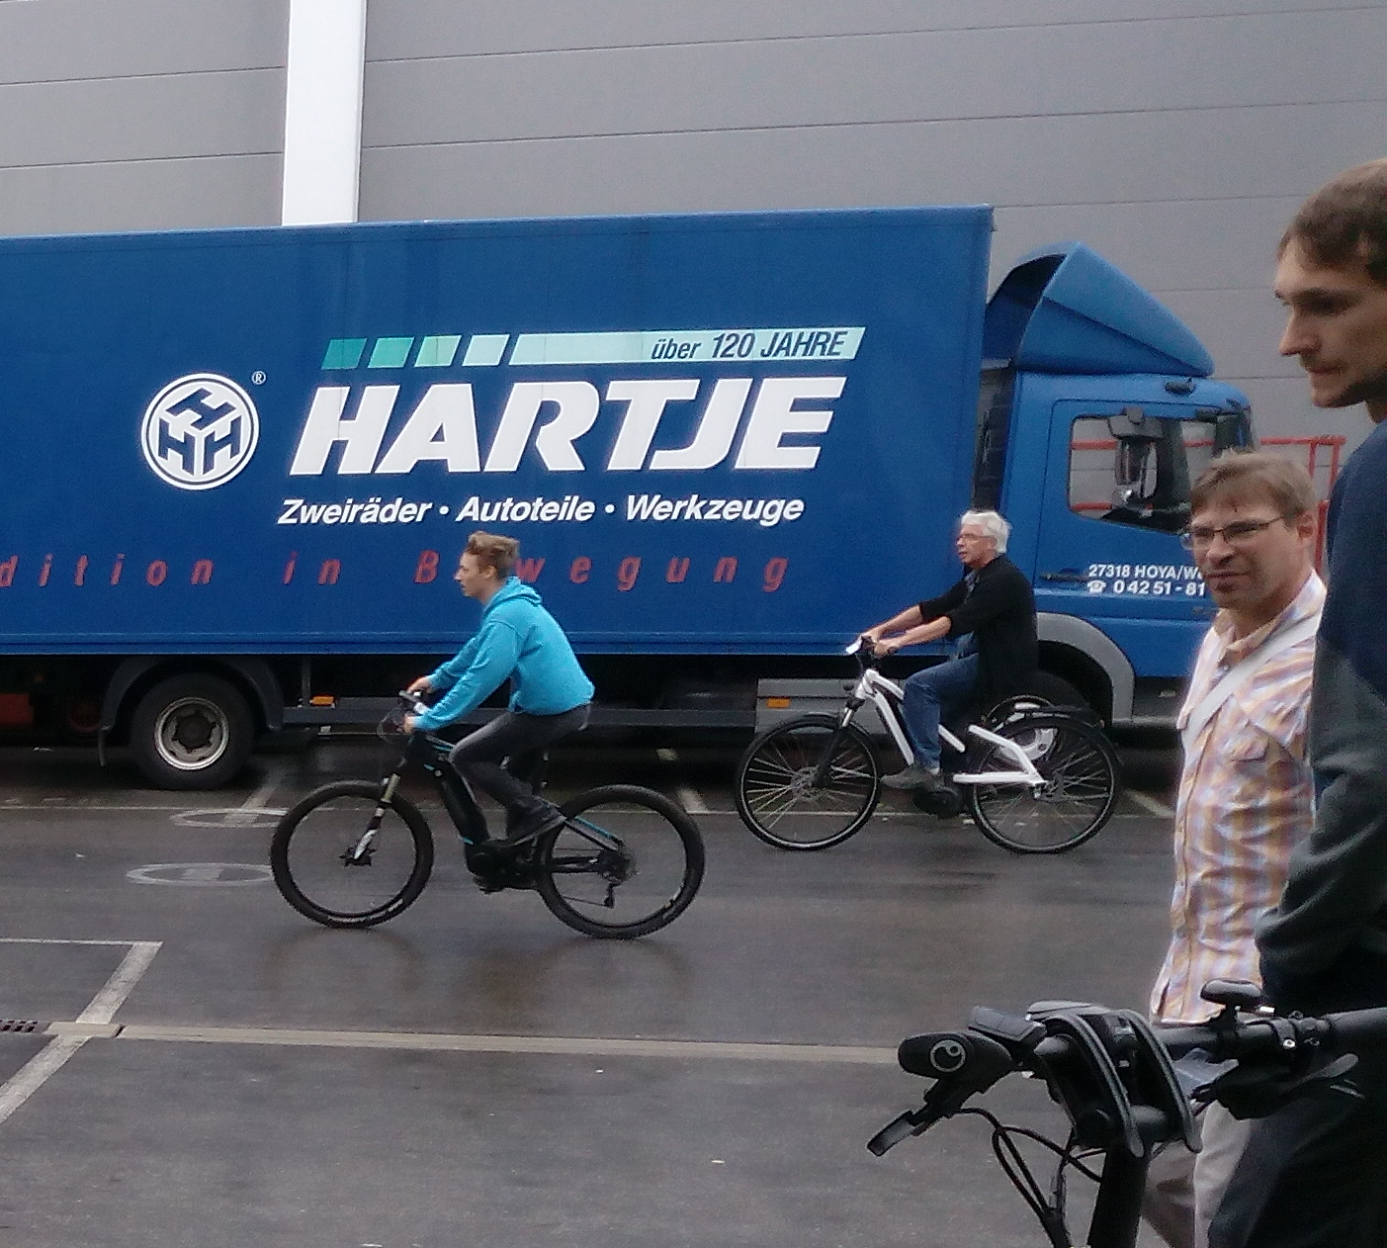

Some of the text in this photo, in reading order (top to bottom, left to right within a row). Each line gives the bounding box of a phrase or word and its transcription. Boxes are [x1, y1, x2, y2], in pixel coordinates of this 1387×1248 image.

[651, 331, 848, 360] über 120 JAHRE
[289, 376, 847, 476] HARTJE
[277, 494, 805, 527] Zweiräder Autoteile Werkzeuge
[282, 552, 341, 585] in
[414, 550, 789, 592] Bwegung
[1088, 564, 1130, 578] 27318
